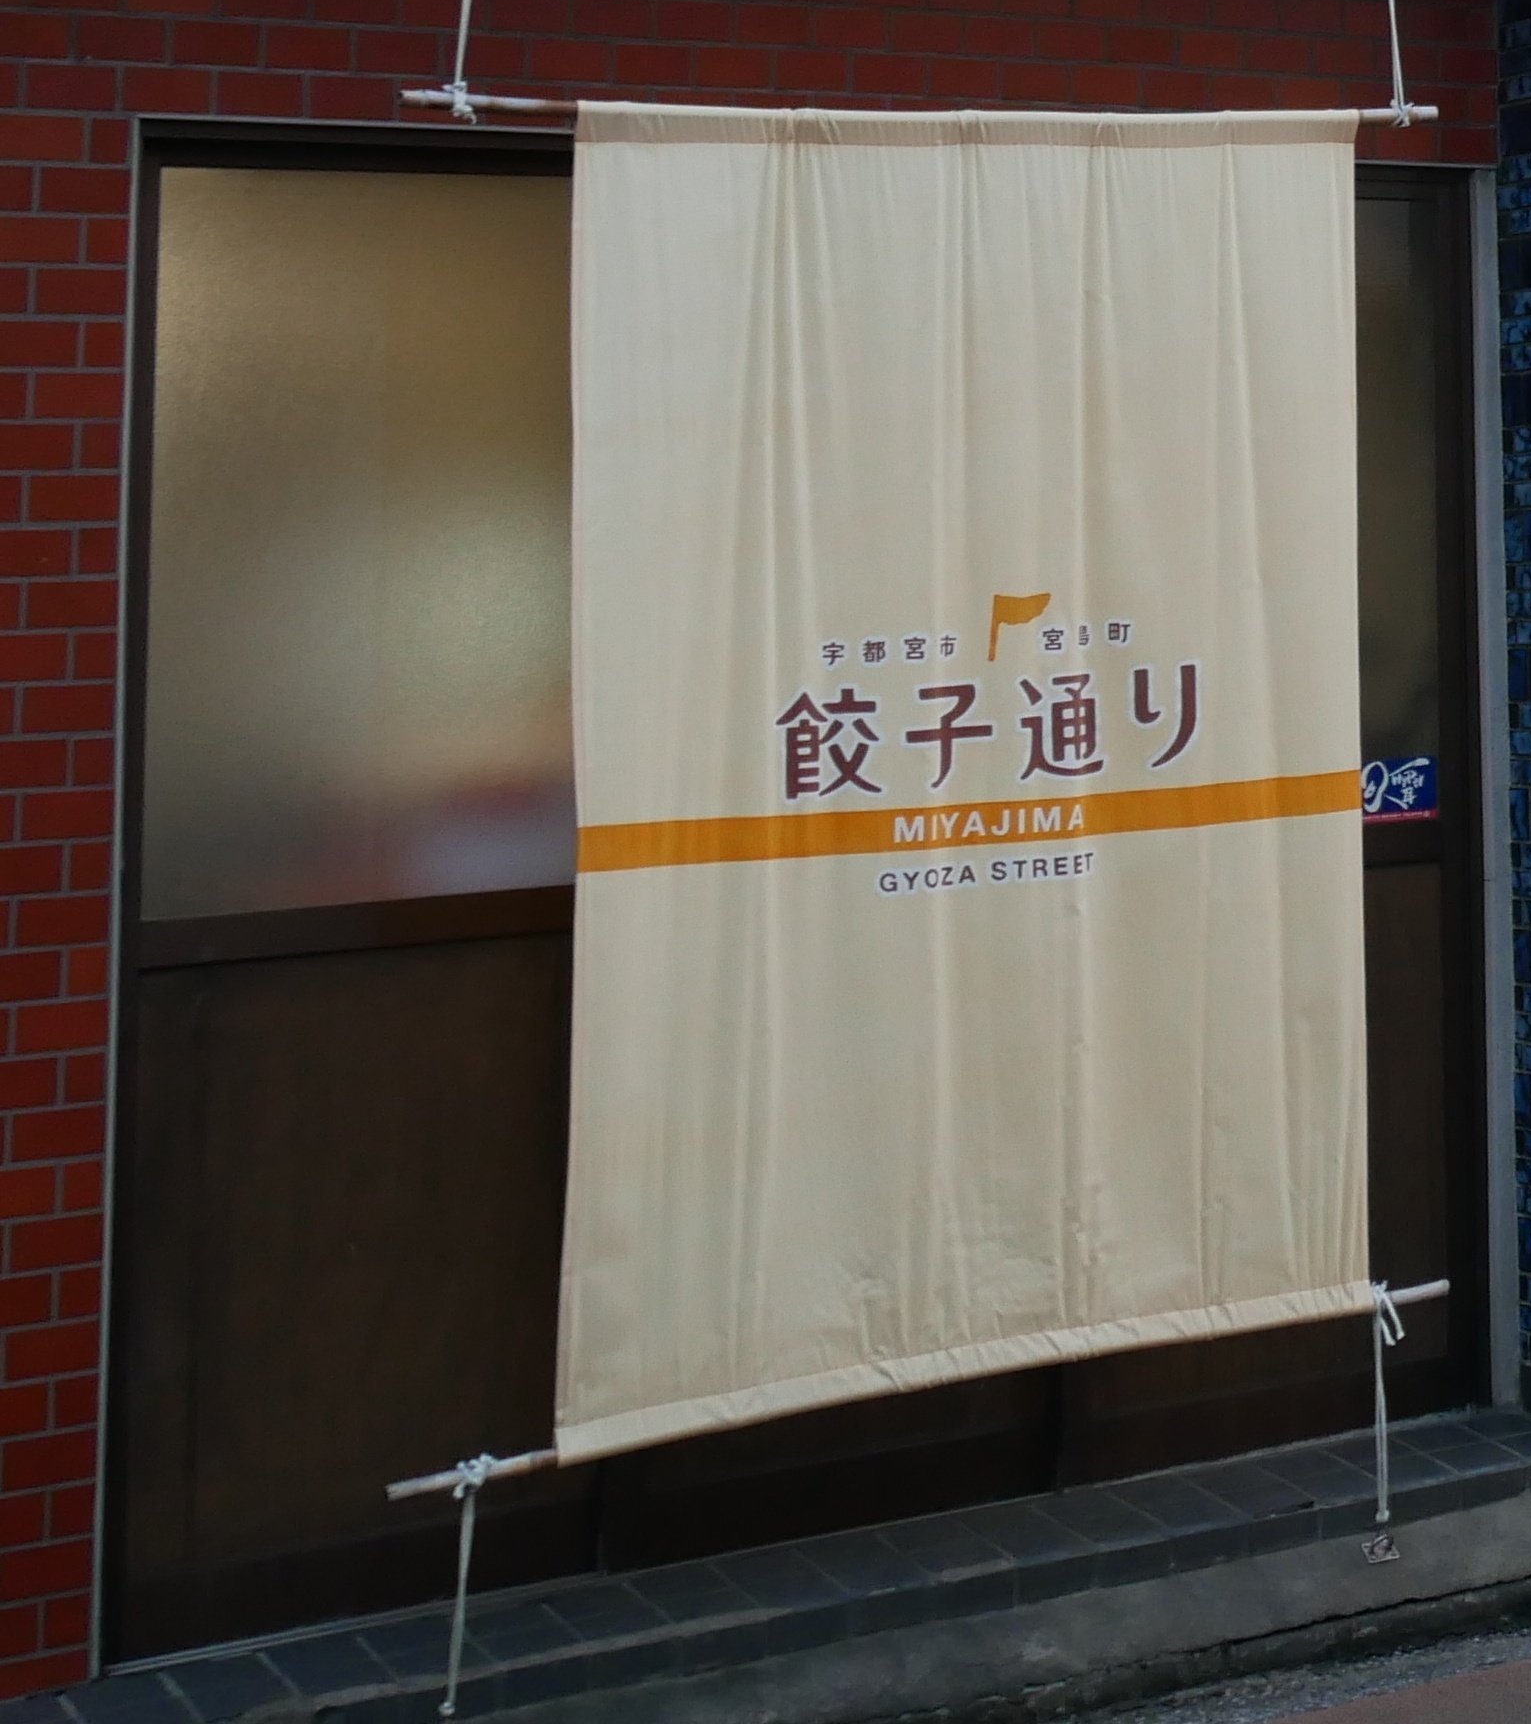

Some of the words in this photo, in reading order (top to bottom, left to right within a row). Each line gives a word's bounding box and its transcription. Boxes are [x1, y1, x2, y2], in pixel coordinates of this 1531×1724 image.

[822, 635, 957, 665] 宇都宮市
[776, 664, 1197, 800] 餃子通り
[893, 805, 1085, 843] MIYAJIMA
[880, 864, 976, 893] GYOZA
[991, 853, 1094, 882] STREET
